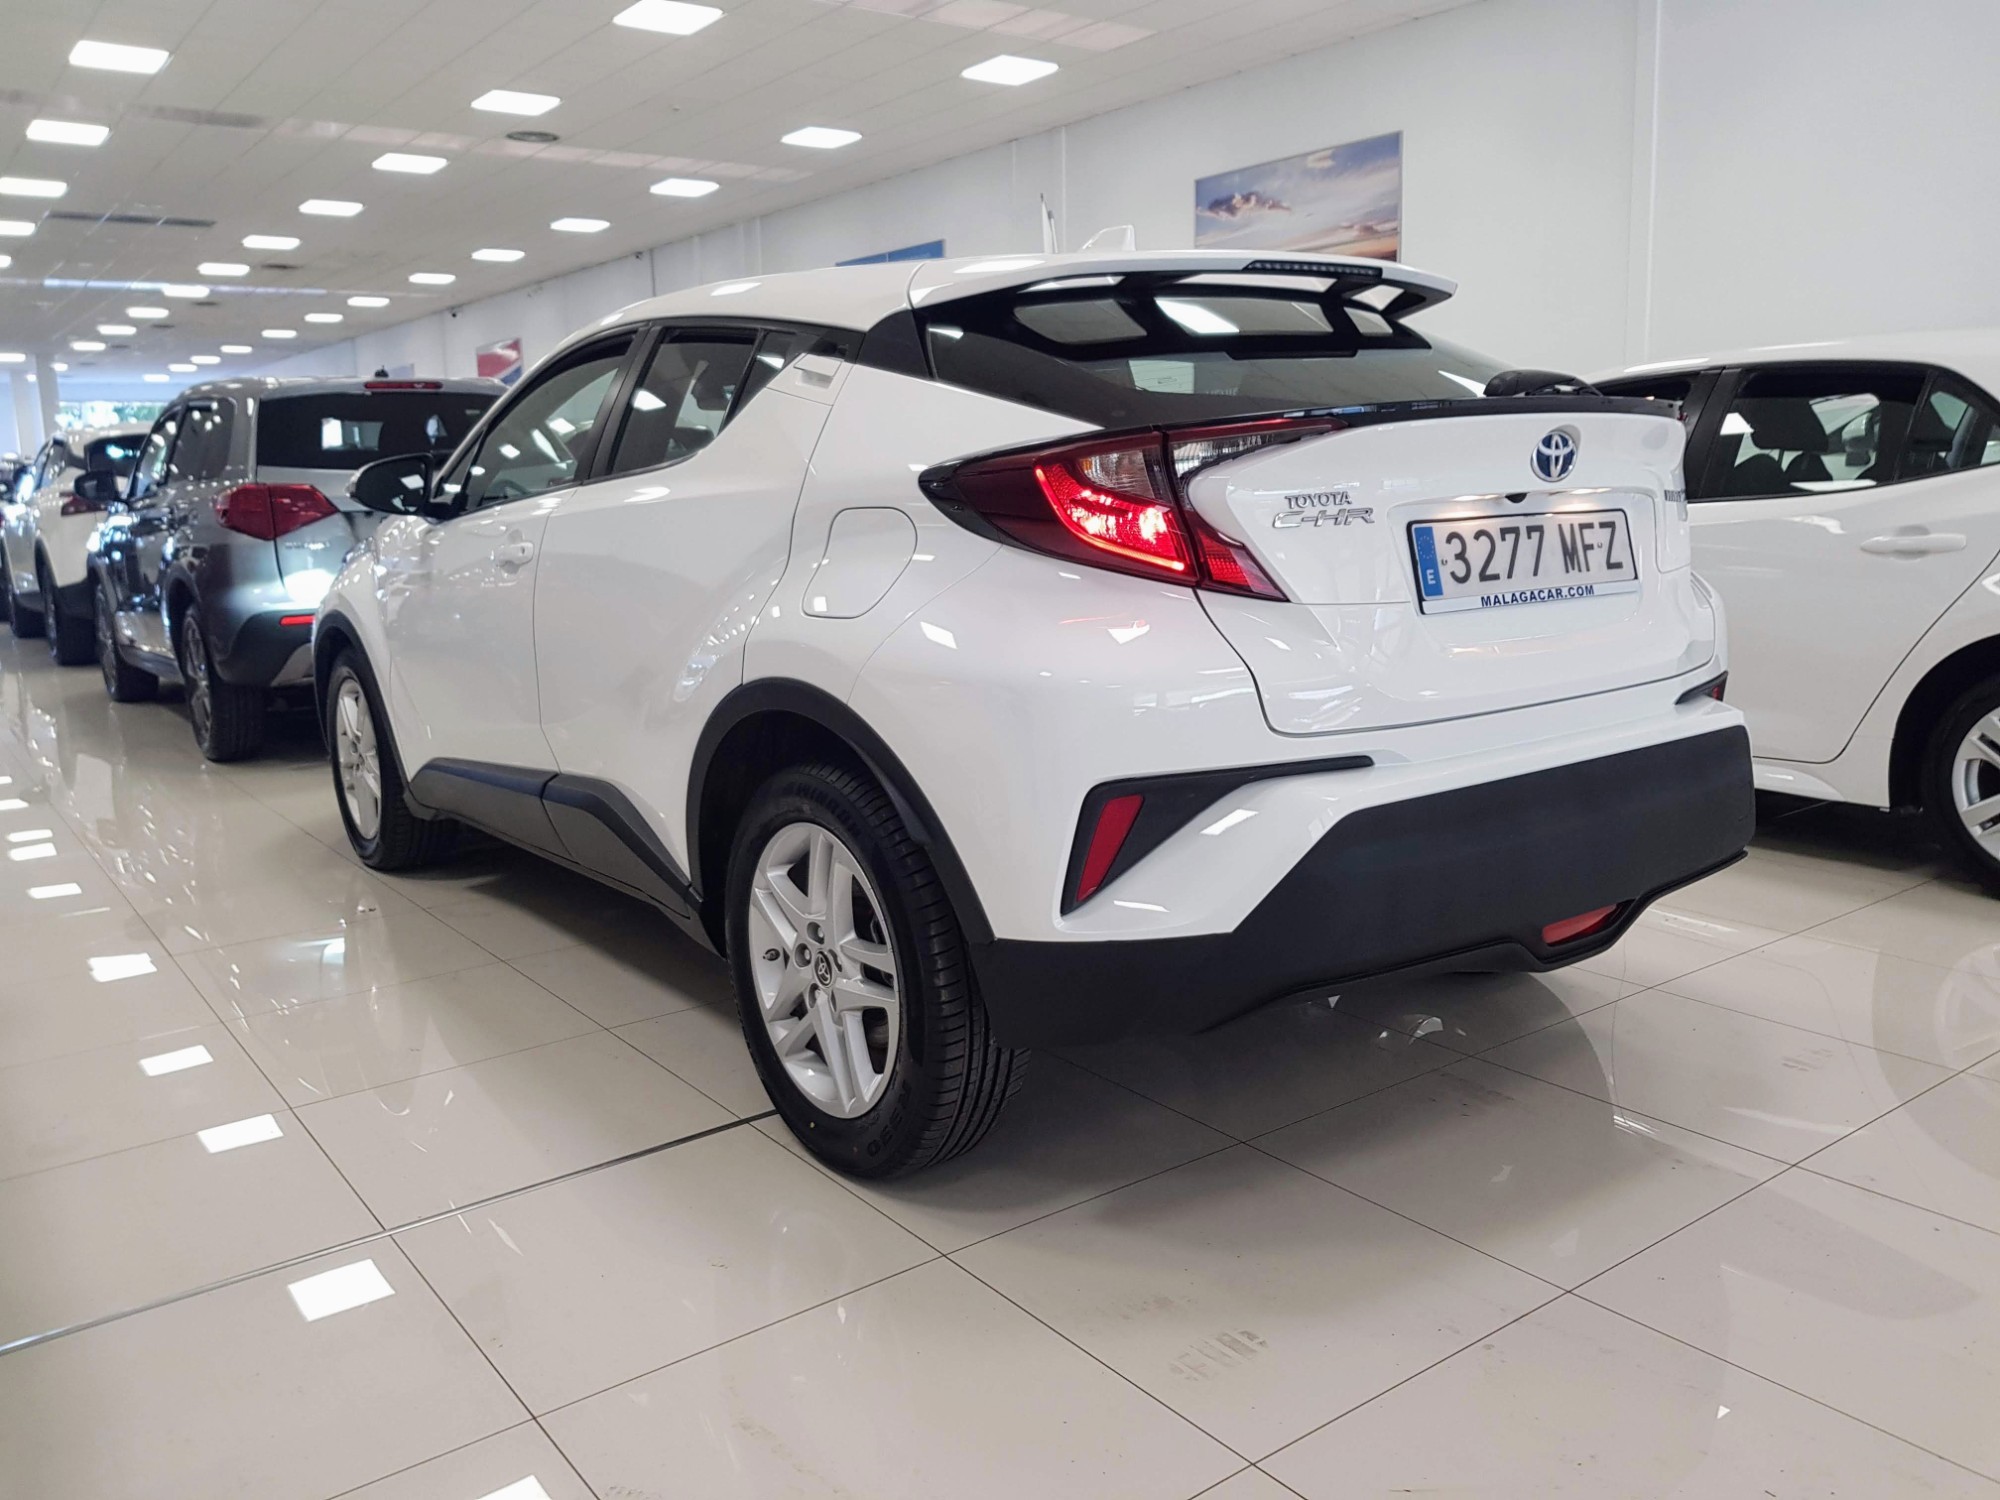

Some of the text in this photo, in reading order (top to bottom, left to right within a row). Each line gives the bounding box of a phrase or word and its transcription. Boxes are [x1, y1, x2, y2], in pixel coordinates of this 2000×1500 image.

[1284, 491, 1352, 509] TOYOTA
[1272, 508, 1375, 528] C-HR
[1445, 521, 1623, 584] 3277 MFZ
[1426, 569, 1436, 585] E
[1480, 585, 1594, 607] MALAGACAR.COM
